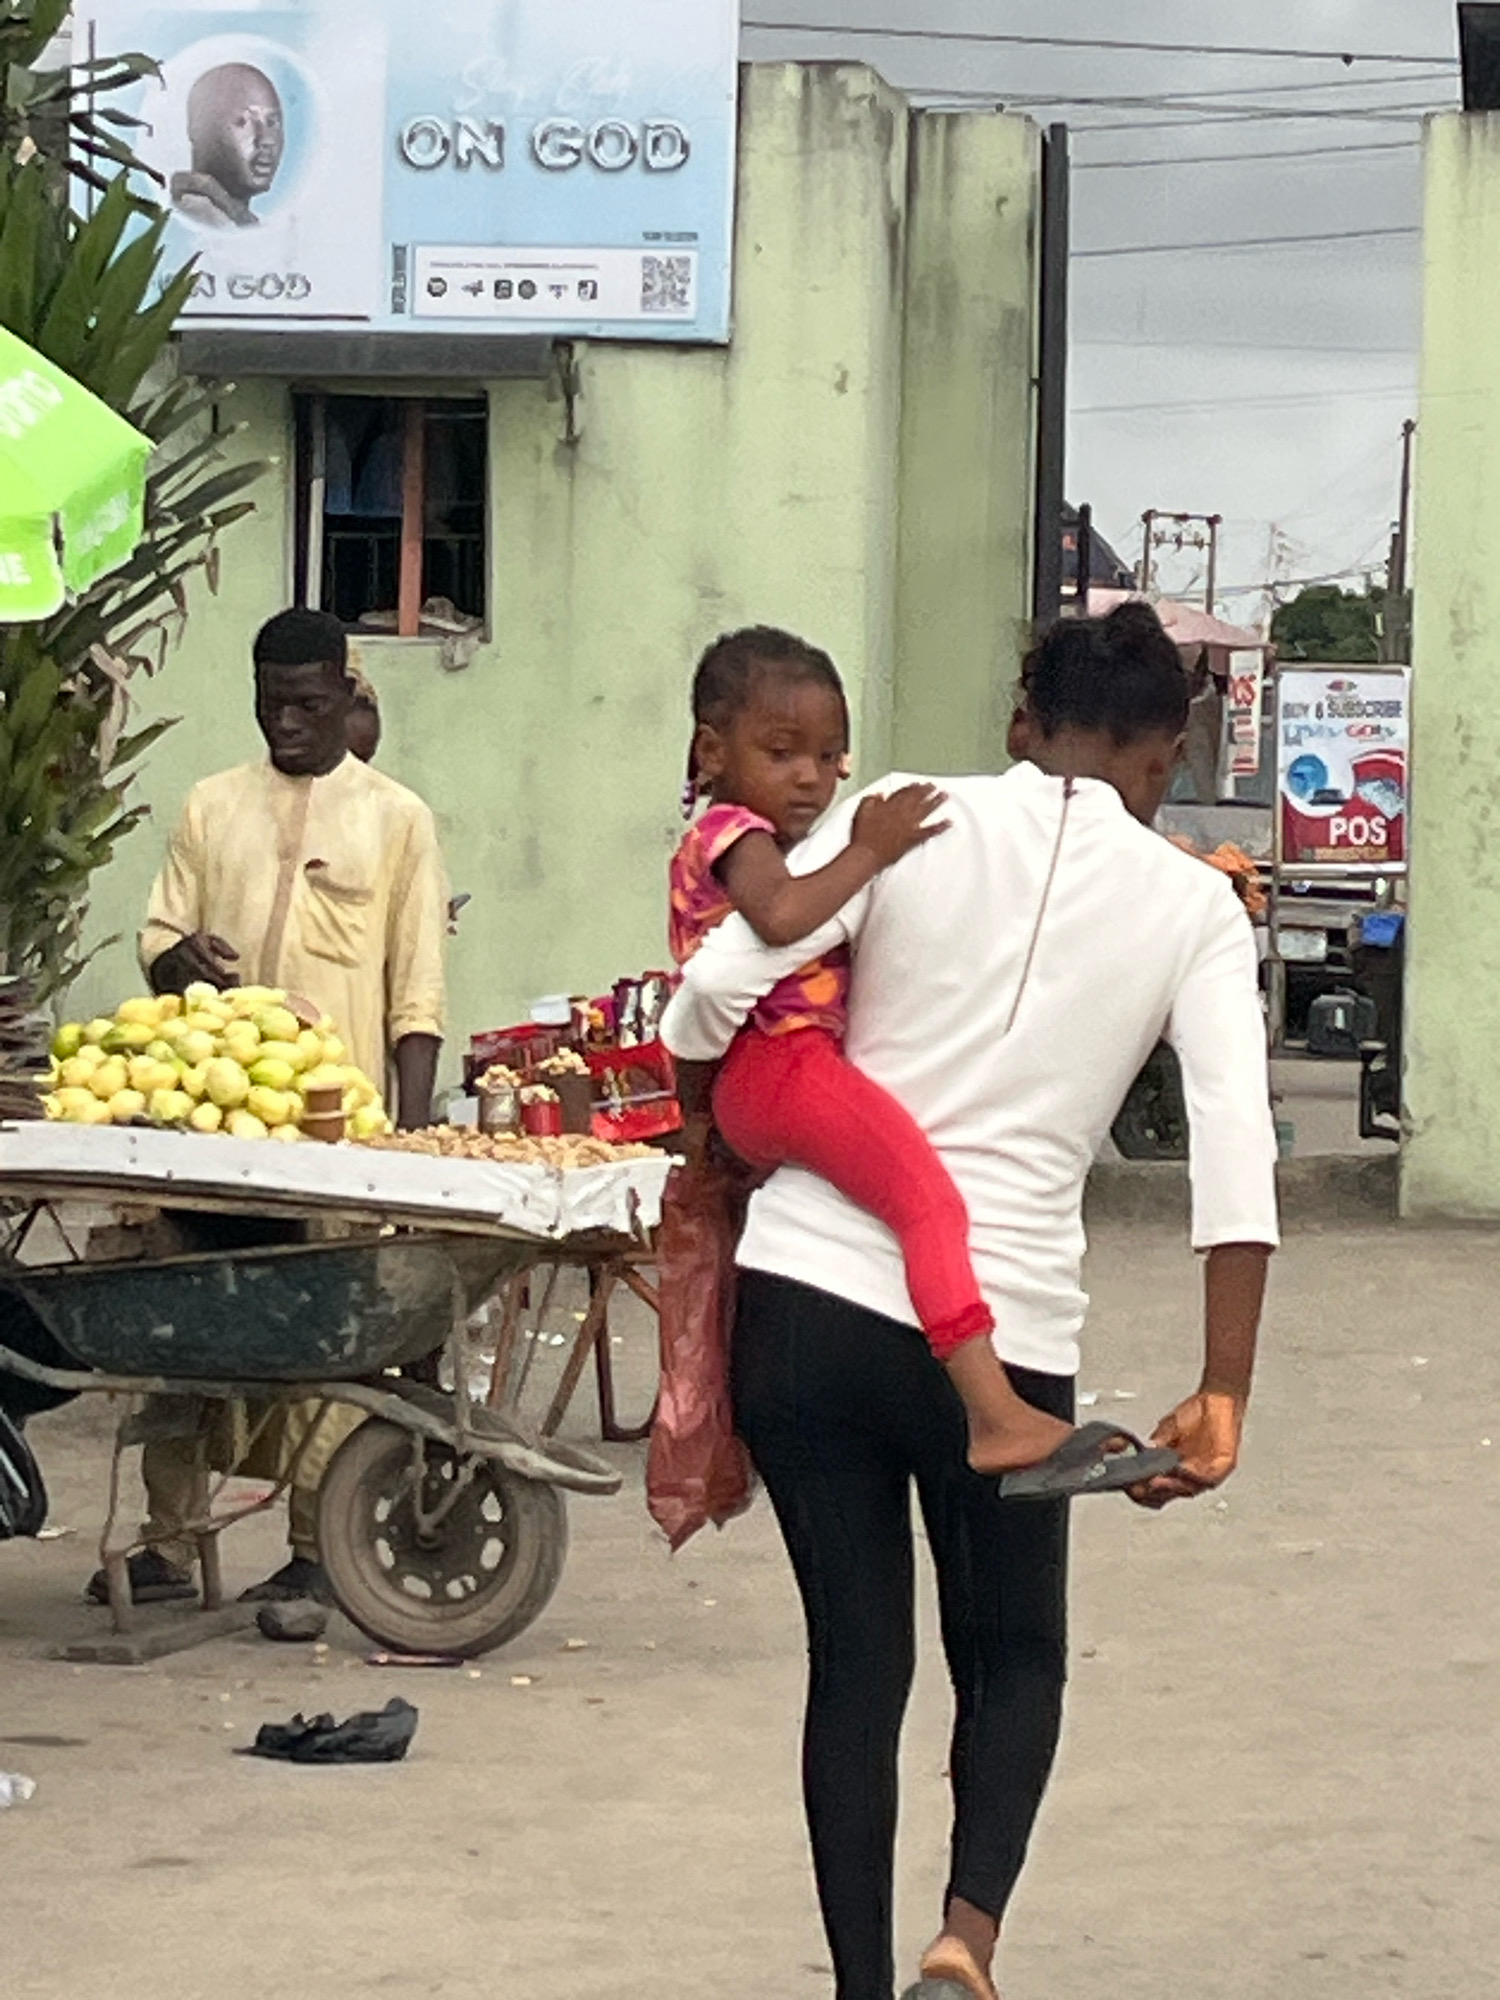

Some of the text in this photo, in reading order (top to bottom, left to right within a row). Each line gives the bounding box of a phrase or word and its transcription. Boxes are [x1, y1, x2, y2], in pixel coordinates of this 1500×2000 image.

[399, 114, 691, 172] ON GOD
[226, 272, 312, 300] GOD
[1329, 815, 1387, 846] POS
